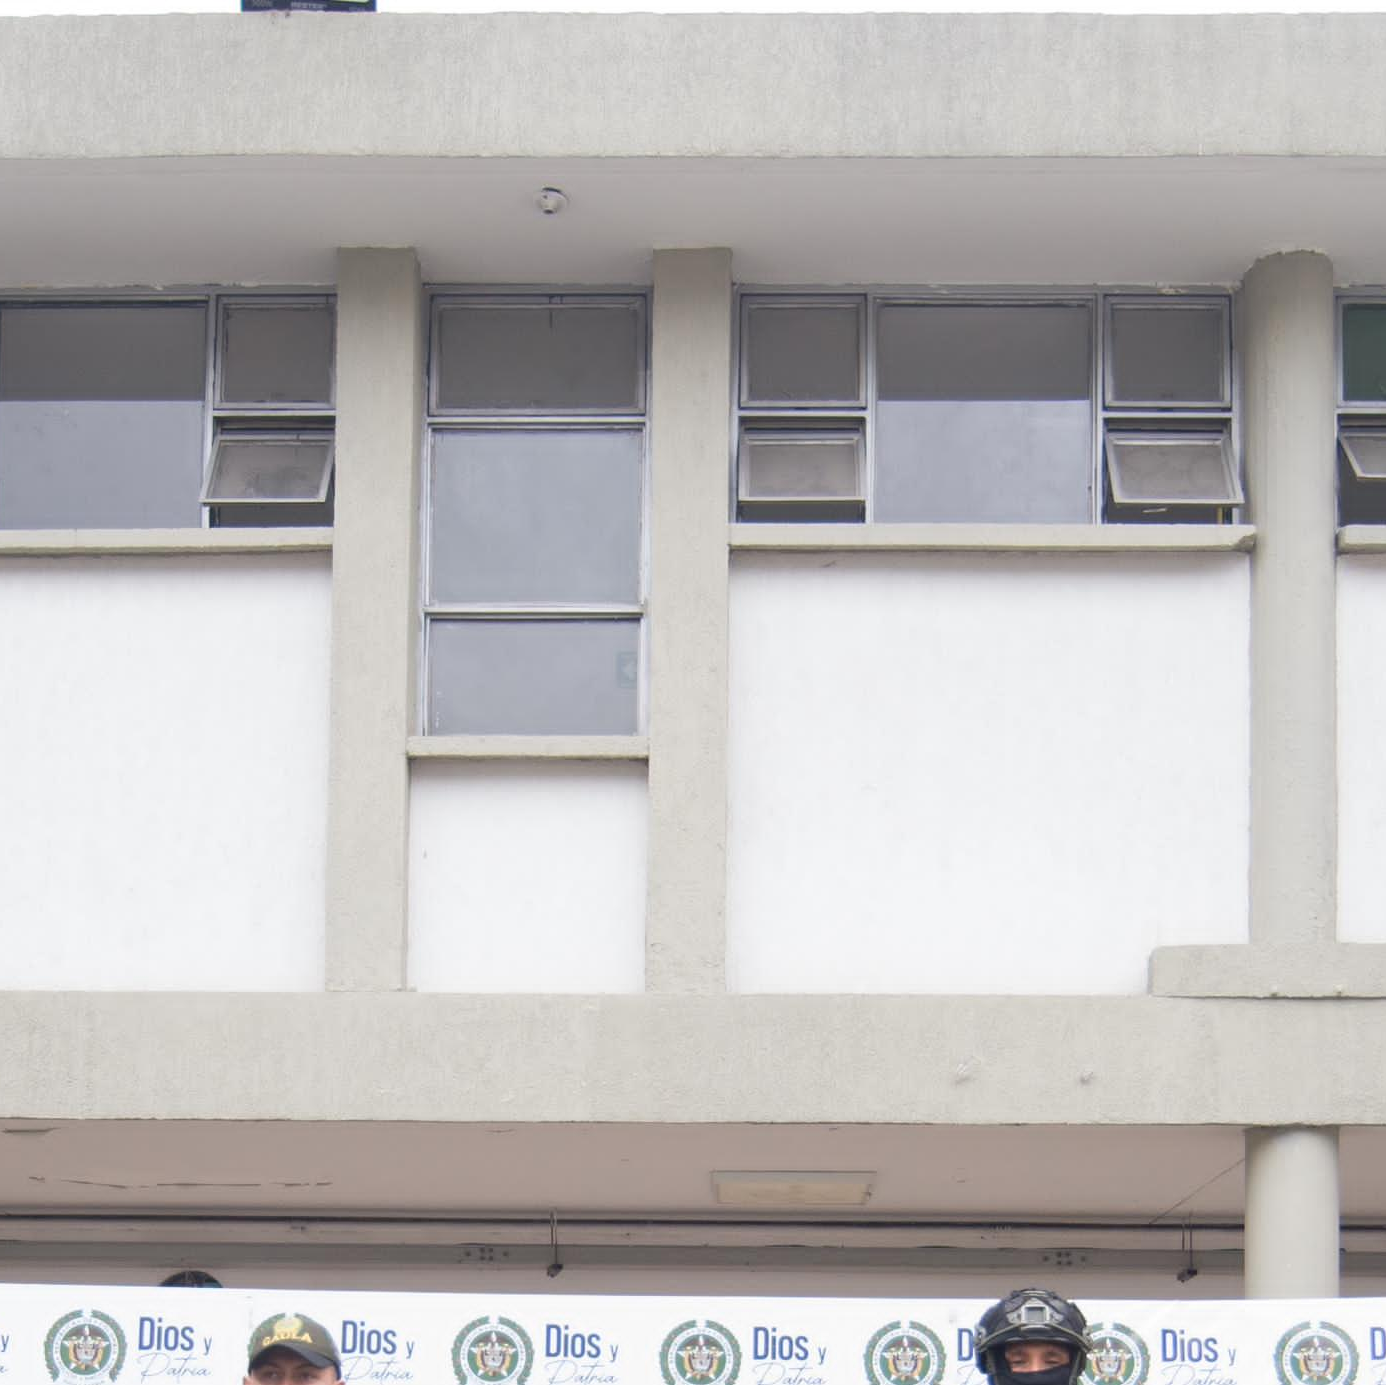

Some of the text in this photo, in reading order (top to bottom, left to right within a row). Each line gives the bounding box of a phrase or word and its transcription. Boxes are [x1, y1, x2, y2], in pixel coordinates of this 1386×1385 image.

[1, 1335, 9, 1352] y
[138, 1317, 212, 1356] Dios y
[262, 1331, 313, 1347] GAULA
[341, 1320, 414, 1359] Dios y
[545, 1324, 618, 1363] Dios y
[753, 1327, 826, 1365] Dios y
[1161, 1329, 1236, 1366] Dios y
[136, 1350, 211, 1384] Patria
